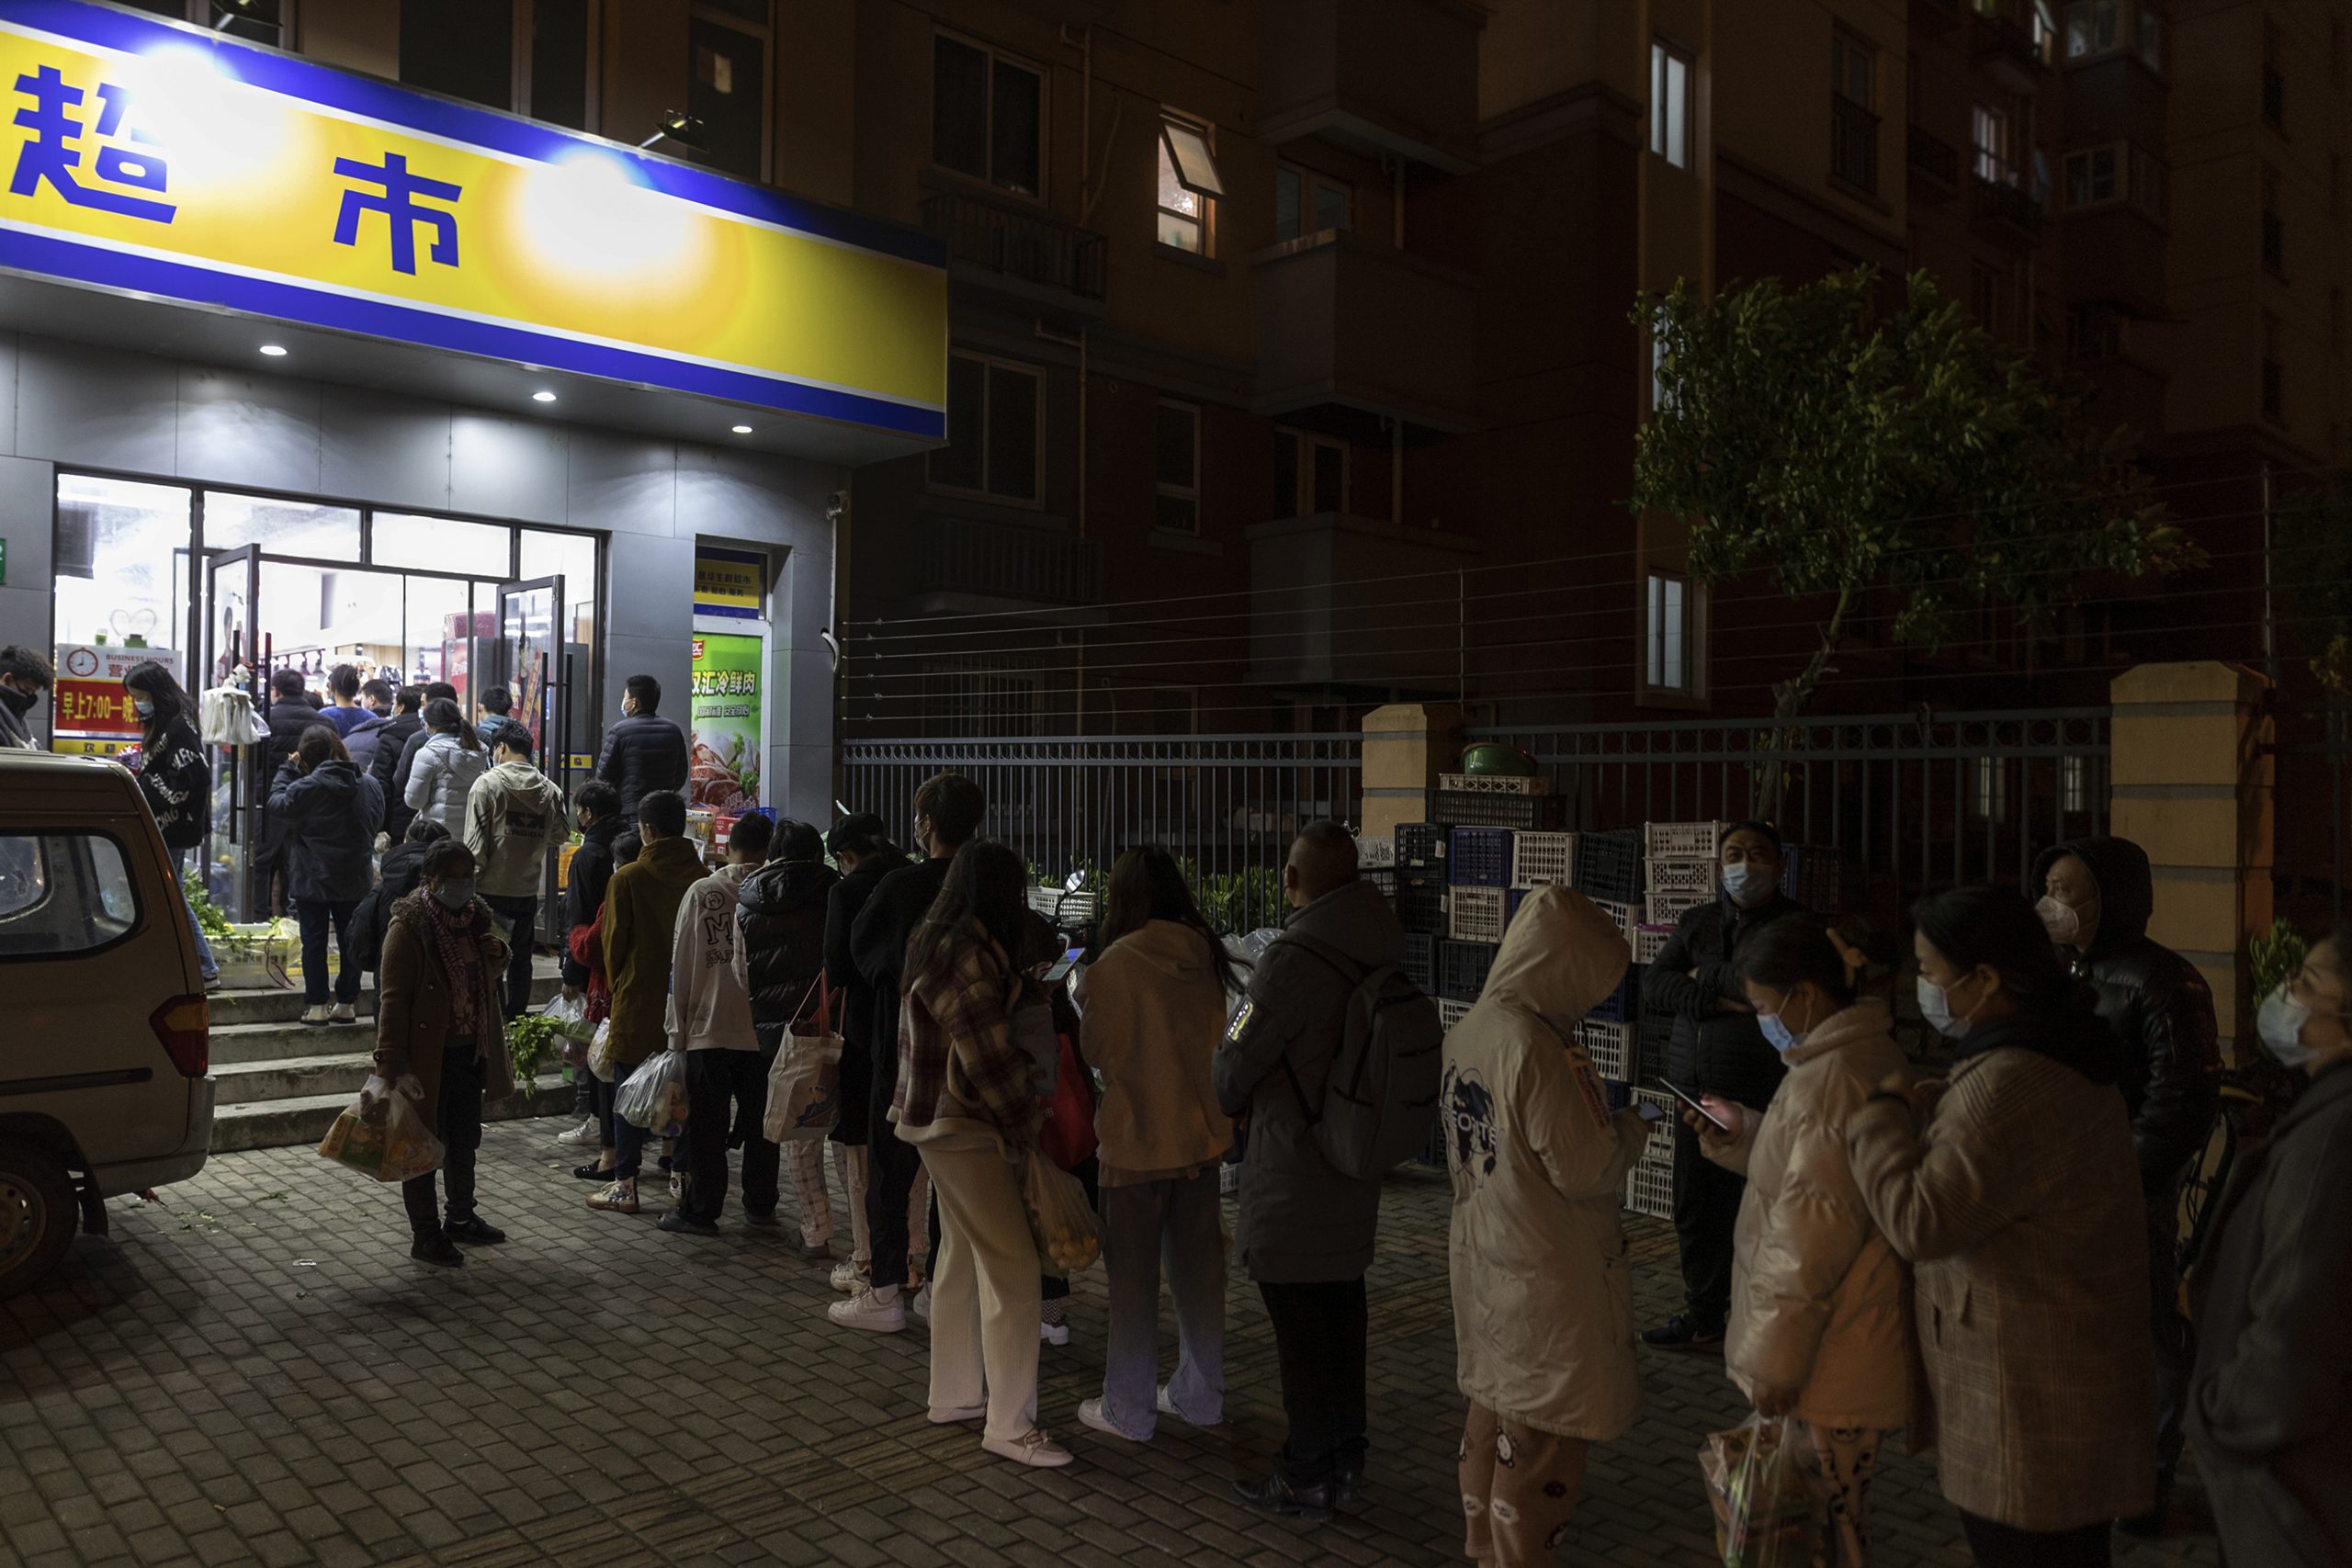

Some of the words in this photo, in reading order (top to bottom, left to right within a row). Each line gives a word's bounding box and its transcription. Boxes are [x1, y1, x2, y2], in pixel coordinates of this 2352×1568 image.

[10, 64, 462, 276] 超市
[106, 654, 144, 662] BUSINESS
[146, 656, 175, 664] HOURS
